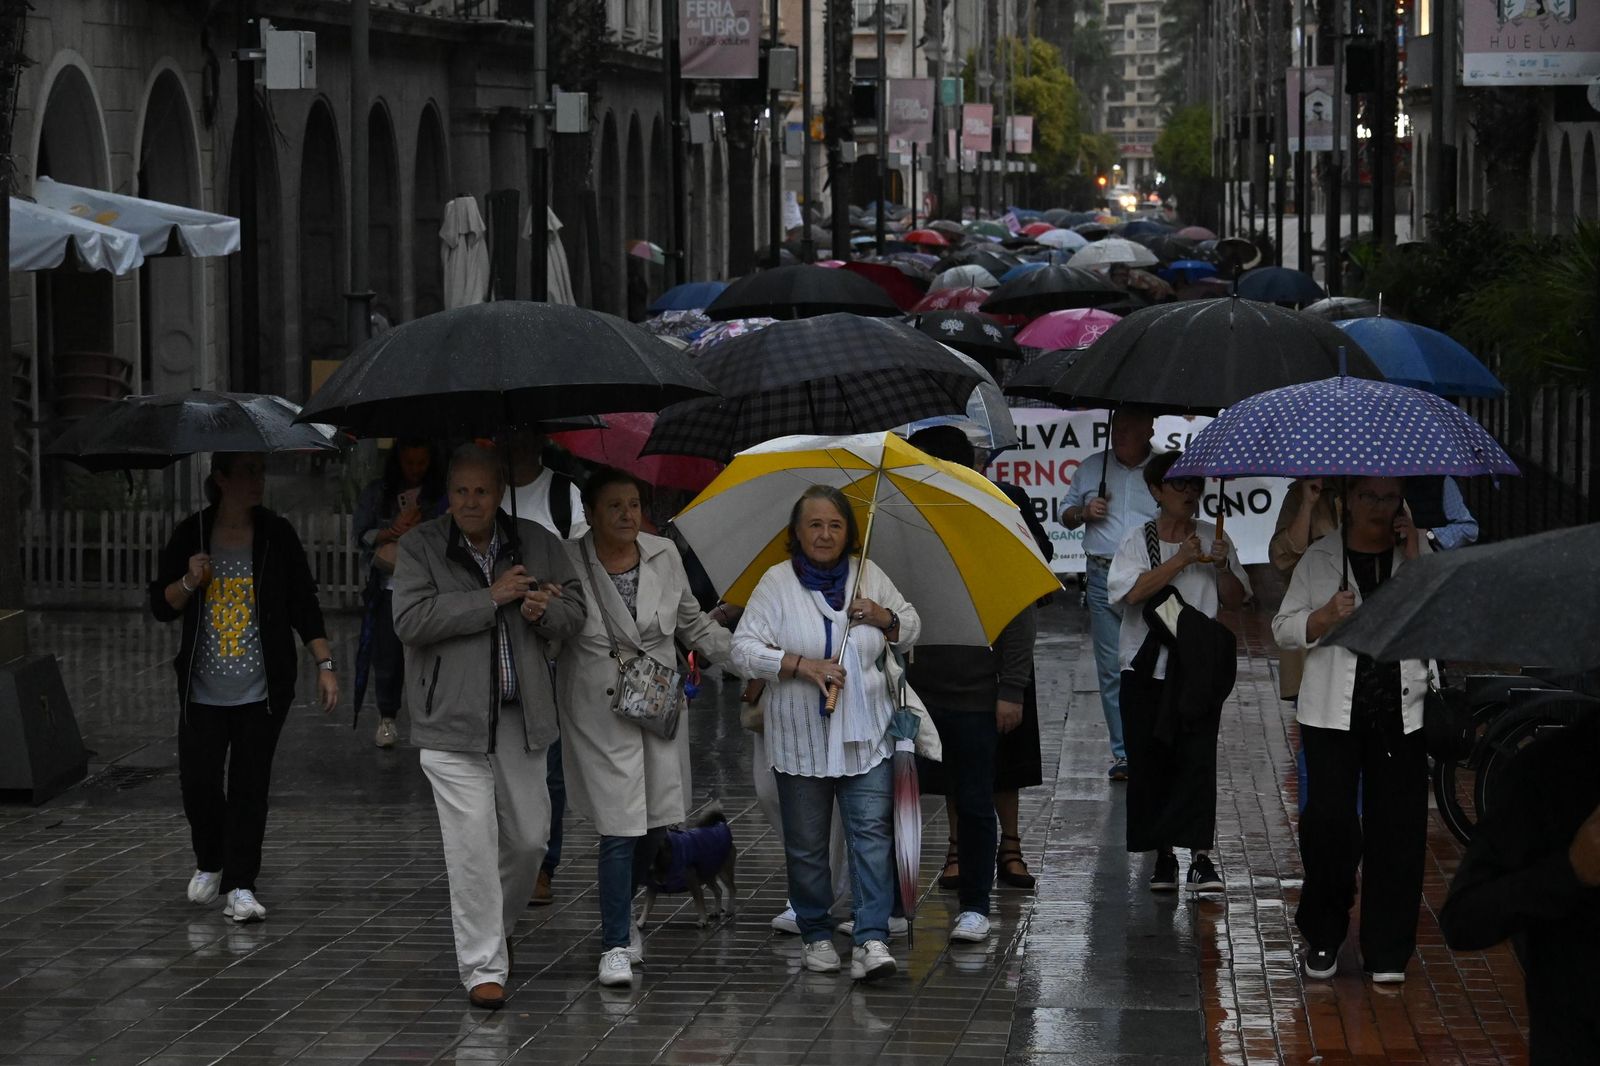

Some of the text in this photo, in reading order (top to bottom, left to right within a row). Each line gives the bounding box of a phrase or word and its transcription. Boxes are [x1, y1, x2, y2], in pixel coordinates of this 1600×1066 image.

[687, 0, 735, 18] FERIA
[702, 17, 750, 36] LIBRO
[1490, 34, 1576, 49] HUELVA
[212, 603, 250, 630] DO
